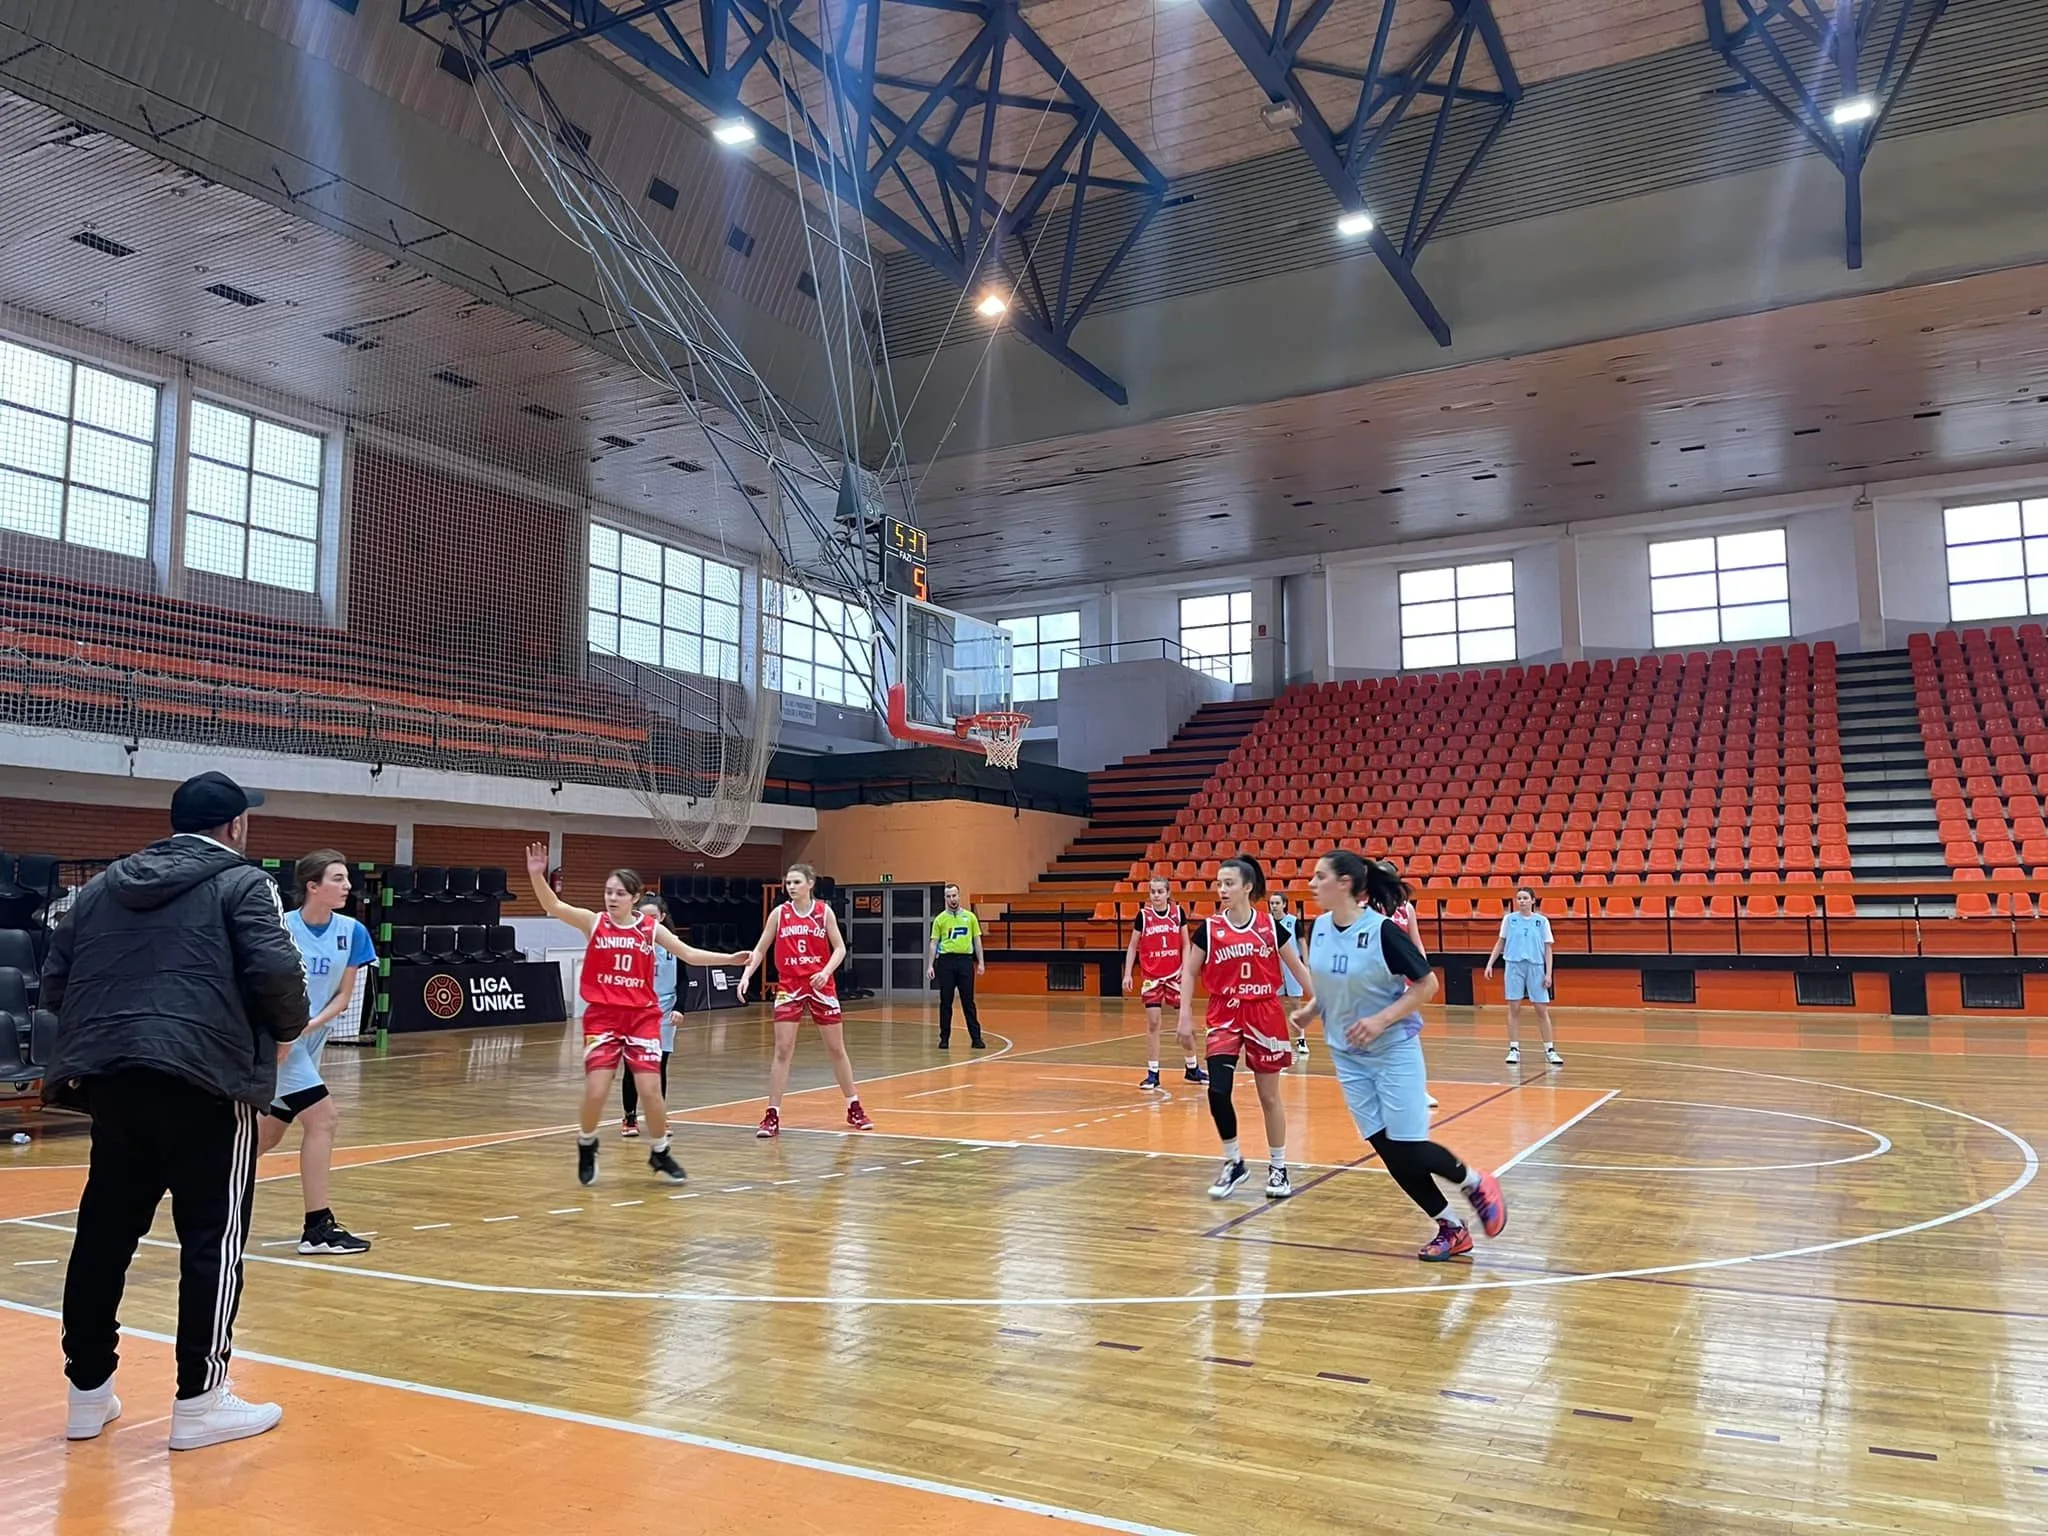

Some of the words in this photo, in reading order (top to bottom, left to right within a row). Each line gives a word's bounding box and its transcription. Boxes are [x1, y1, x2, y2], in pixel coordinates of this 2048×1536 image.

[899, 550, 913, 563] FAZI
[914, 567, 927, 602] 5
[797, 939, 808, 953] 6
[1161, 935, 1168, 948] 1
[311, 957, 330, 975] 16
[613, 953, 633, 971] 10
[1240, 962, 1251, 979] 0
[1331, 954, 1349, 974] 10
[469, 976, 513, 993] LIGA
[614, 975, 645, 988] SPORT
[1238, 983, 1272, 995] SPORT
[471, 993, 526, 1012] UNIKE
